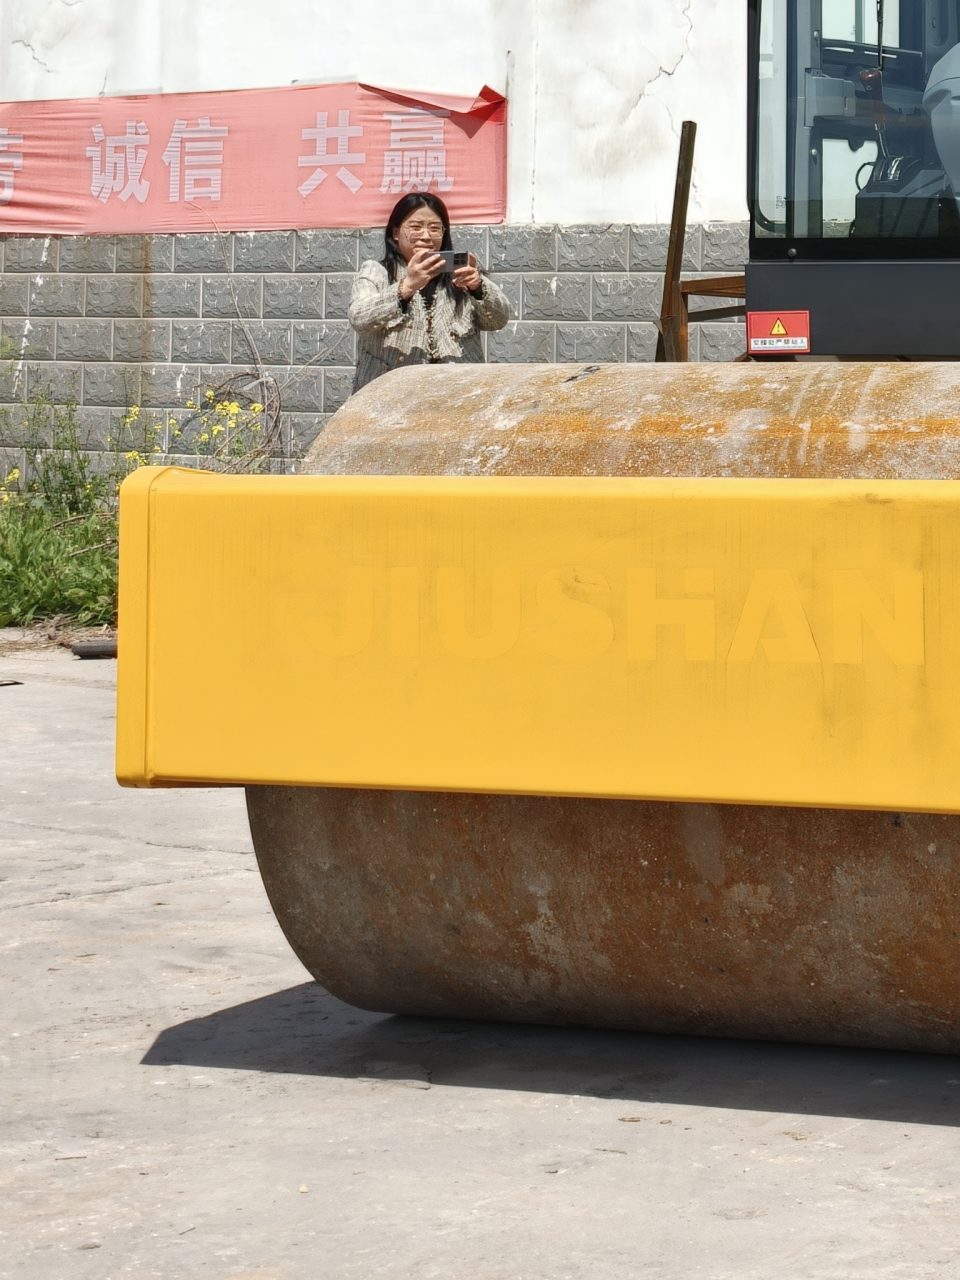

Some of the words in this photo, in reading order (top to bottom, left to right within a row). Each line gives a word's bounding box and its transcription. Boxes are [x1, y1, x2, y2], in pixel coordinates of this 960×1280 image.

[86, 115, 229, 205] 诚信
[298, 107, 454, 197] 共赢
[304, 566, 924, 666] JIUSHAN
